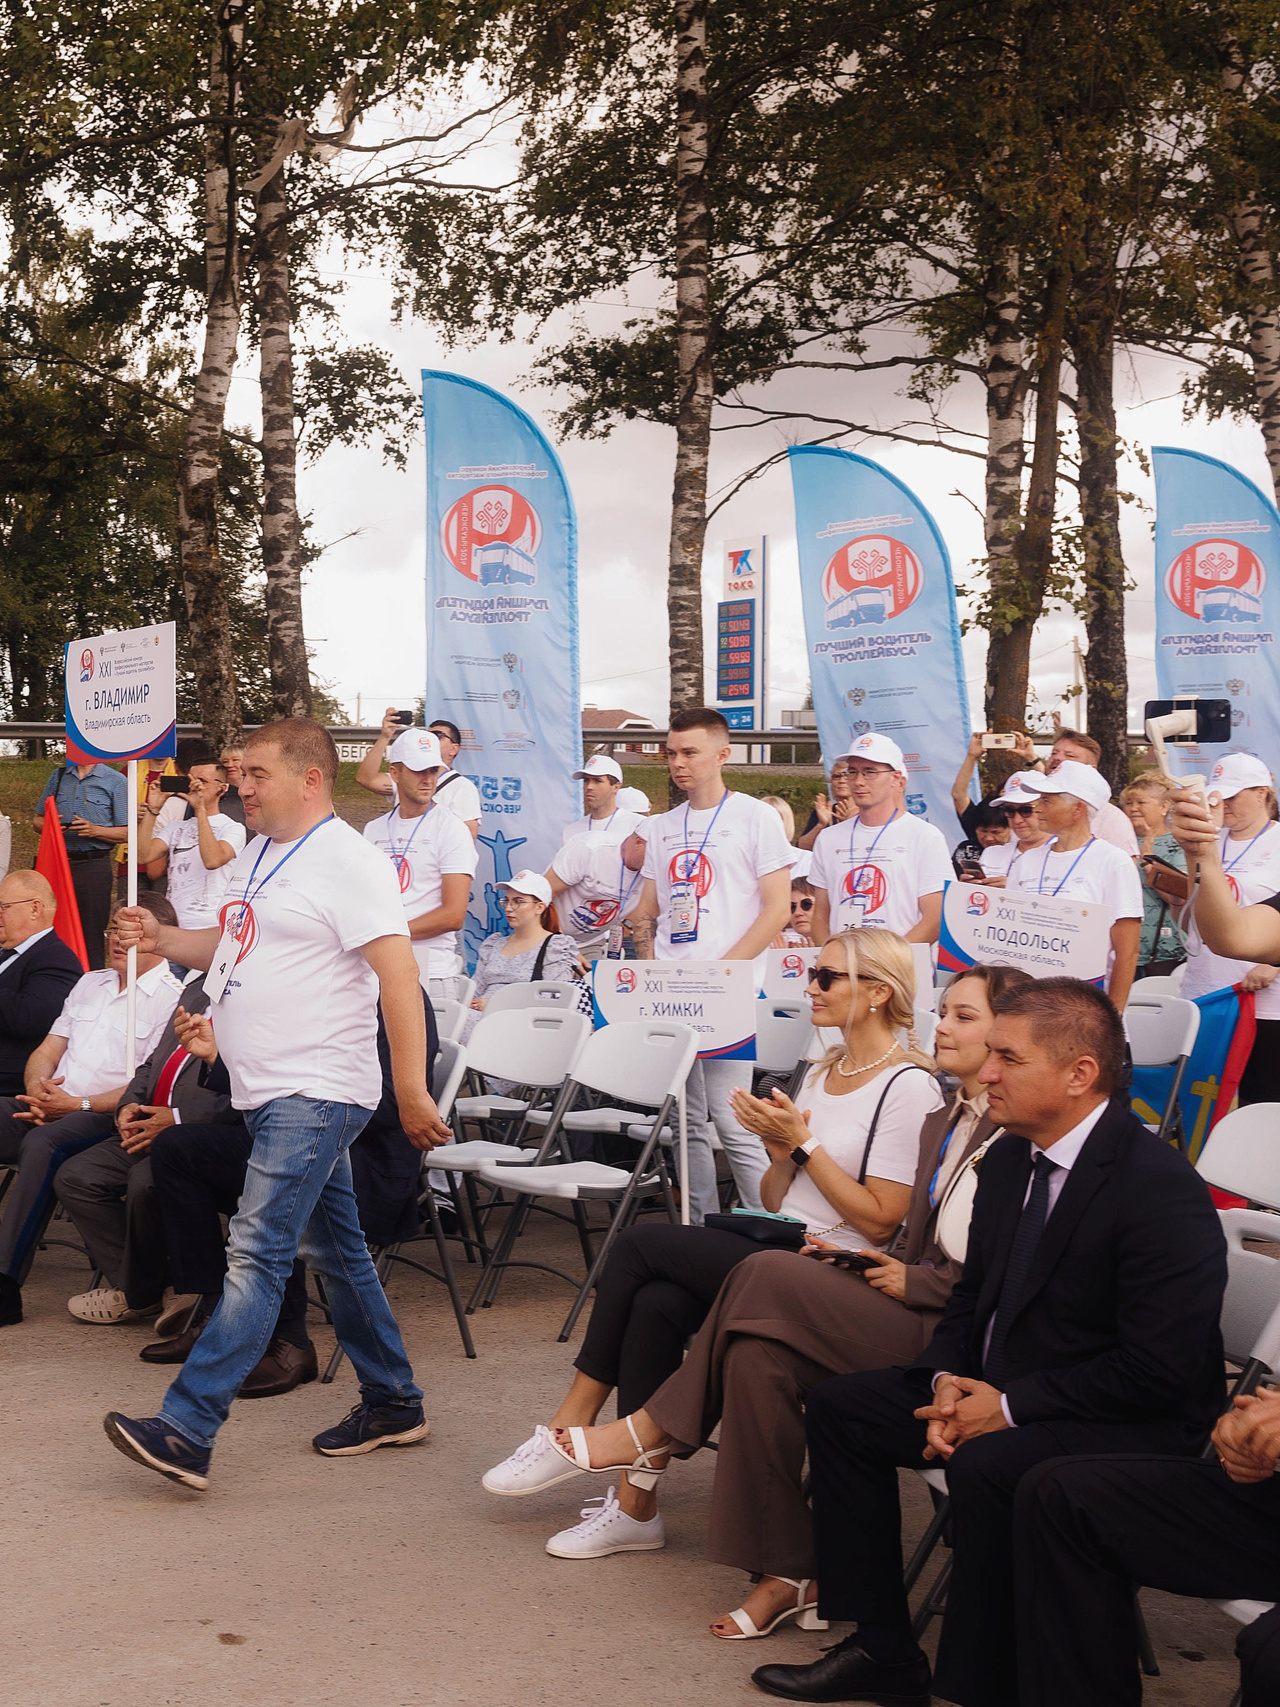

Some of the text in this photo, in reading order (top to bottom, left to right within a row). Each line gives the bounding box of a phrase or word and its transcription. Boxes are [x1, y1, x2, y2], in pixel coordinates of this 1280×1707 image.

[814, 633, 932, 653] ЛУЧШИЙ ВОДИТЕЛЬ
[832, 646, 917, 663] ТРОЛЛЕЙБУСА
[99, 660, 112, 679] XXI
[85, 684, 150, 712] г. ВЛАДИМИР
[84, 714, 152, 731] Владимирская область
[996, 906, 1016, 921] XXI
[973, 928, 982, 938] г.
[986, 926, 1070, 953] ПОДОЛЬСК
[977, 944, 1066, 968] Московская область
[219, 963, 226, 975] 4
[644, 980, 663, 993] XXI
[639, 1002, 704, 1017] г. ХИМКИ
